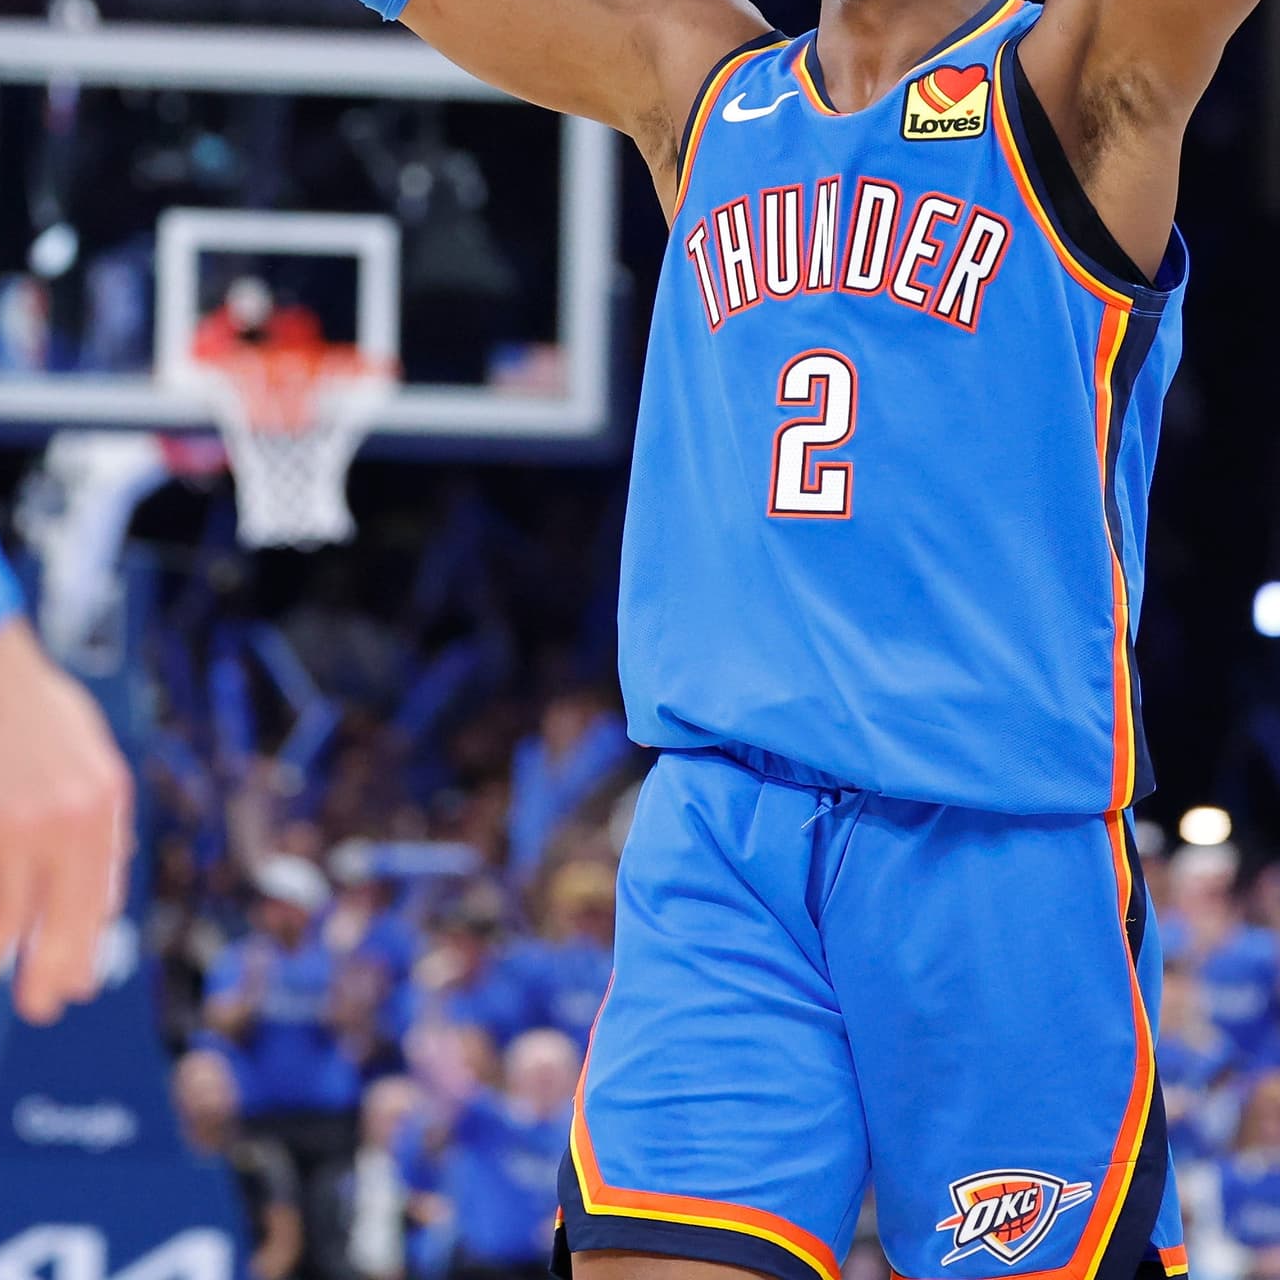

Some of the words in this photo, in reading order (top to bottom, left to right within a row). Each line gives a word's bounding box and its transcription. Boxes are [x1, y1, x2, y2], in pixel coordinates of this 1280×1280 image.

[685, 175, 1010, 334] THUNDER
[767, 348, 858, 520] 2
[958, 1187, 1039, 1244] OKC
